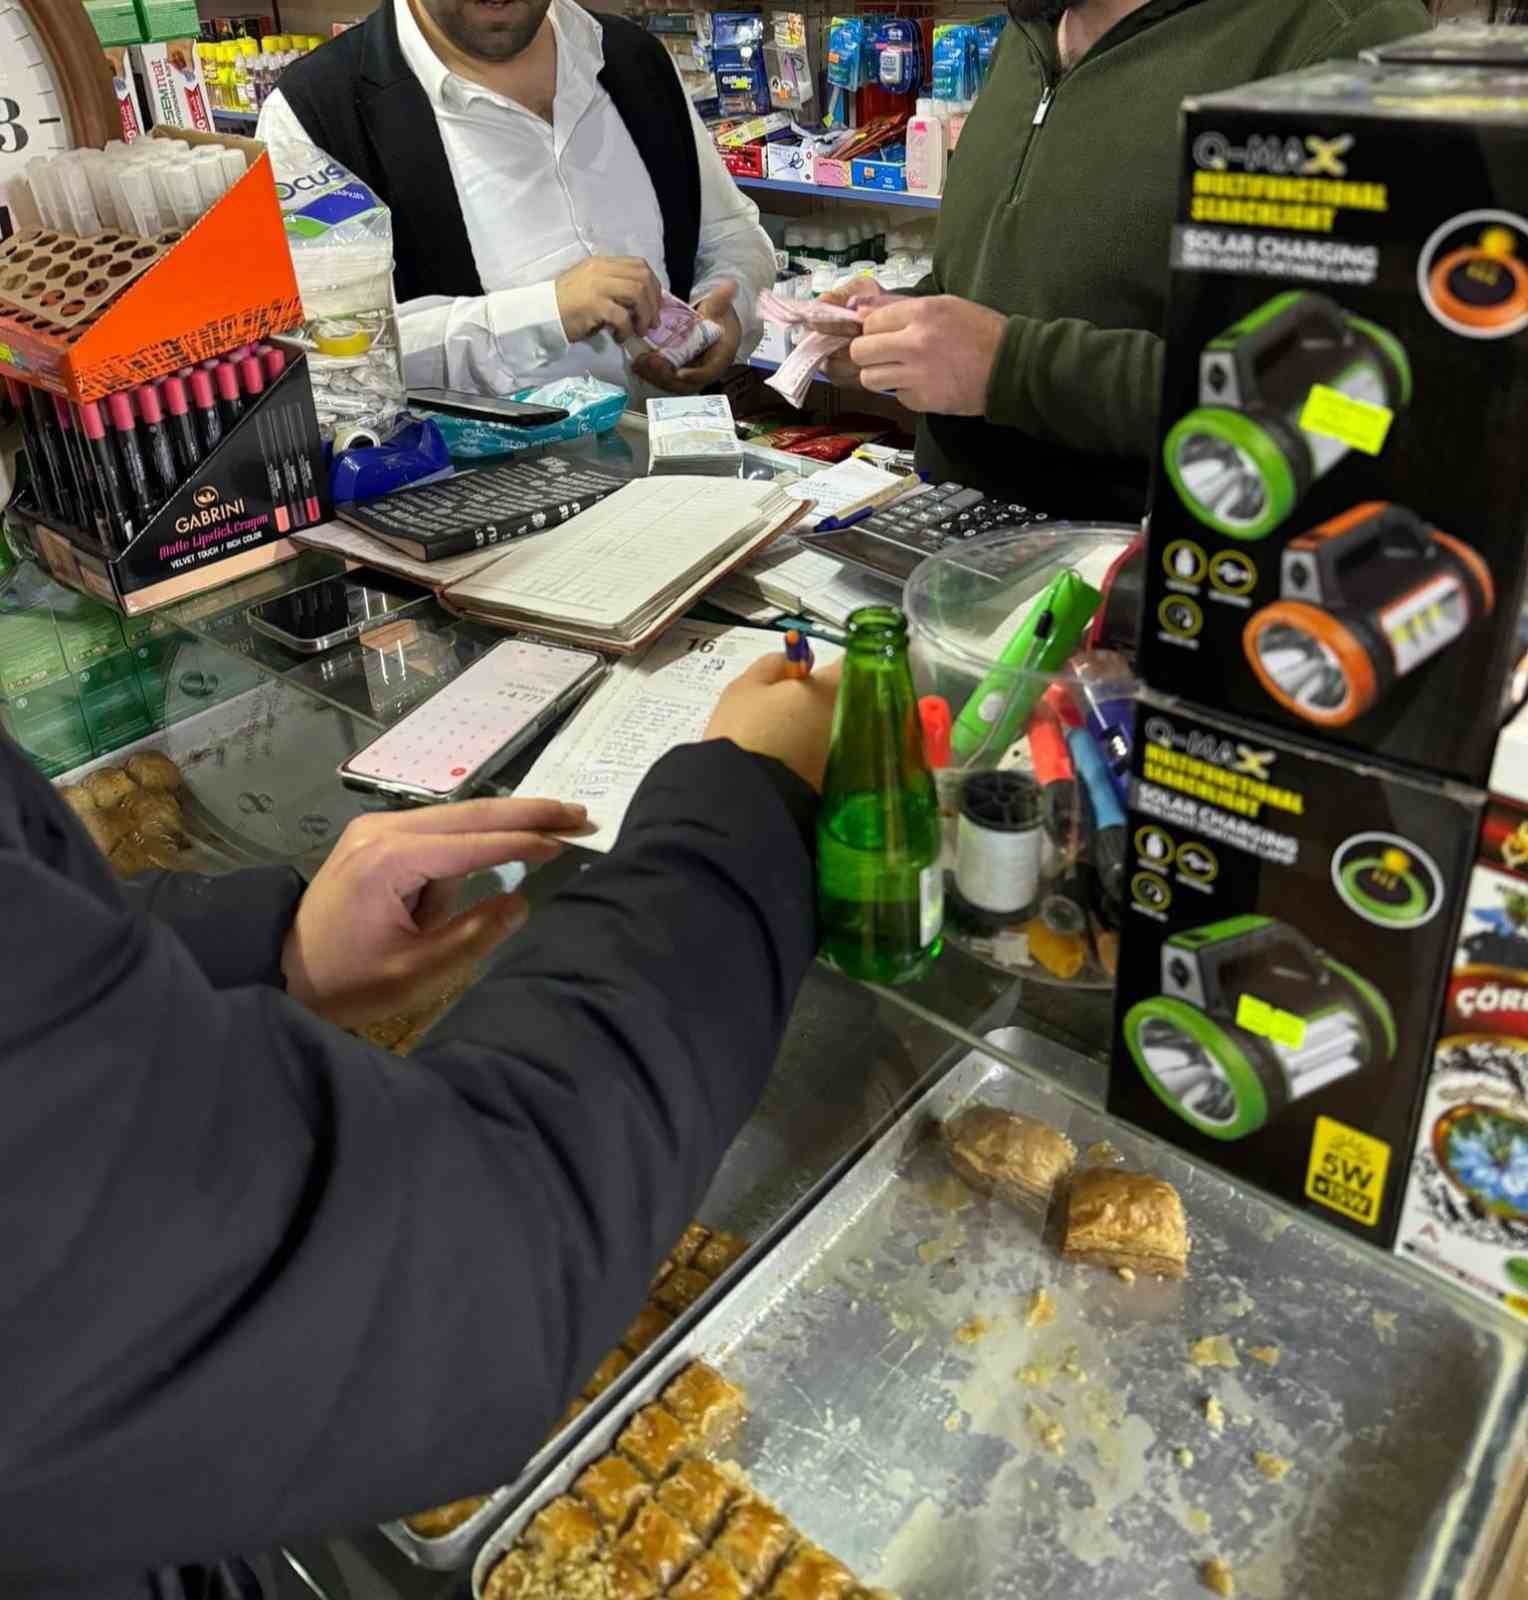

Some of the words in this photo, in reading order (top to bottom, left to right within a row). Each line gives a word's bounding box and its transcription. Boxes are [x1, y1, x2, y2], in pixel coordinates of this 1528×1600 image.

[1192, 131, 1355, 176] Q-MAX
[1193, 170, 1388, 212] MULTIFUNCTIONAL
[1191, 196, 1336, 232] SEARCHLIGHT
[1183, 229, 1255, 254] SOLAR
[1257, 236, 1379, 265] CHARGING
[175, 498, 245, 533] GABRINI
[192, 522, 233, 548] Lipstick
[233, 513, 269, 531] Crayon
[170, 553, 195, 569] VELVET
[197, 546, 219, 560] TOUCH
[226, 539, 242, 550] RICH
[242, 530, 263, 544] COLOR
[687, 638, 717, 654] 16
[1145, 716, 1276, 779] Q-MAX
[1143, 762, 1259, 817] SEARCHLIGHT
[1145, 742, 1304, 815] MULTIFUNCTIONAL
[1139, 783, 1197, 817] SOLAR
[1198, 805, 1298, 853] CHARGING
[1322, 1152, 1374, 1189] 5W
